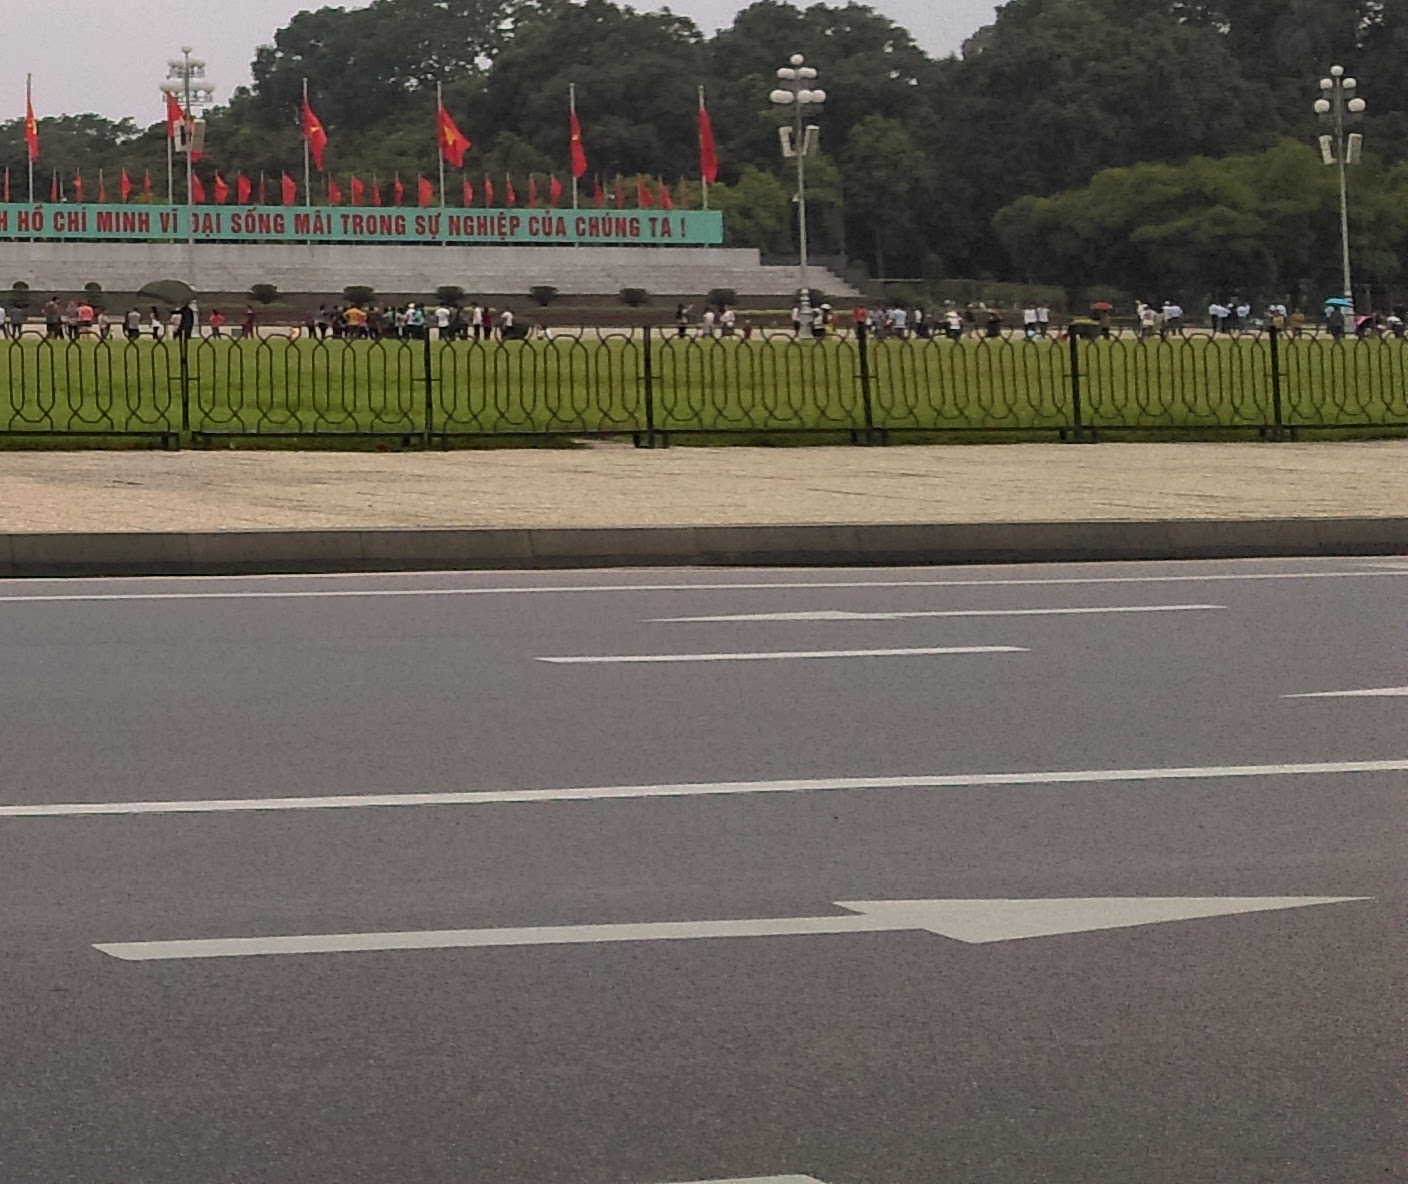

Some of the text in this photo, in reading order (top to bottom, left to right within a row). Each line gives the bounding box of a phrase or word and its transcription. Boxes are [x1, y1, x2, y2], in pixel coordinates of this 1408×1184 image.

[53, 207, 86, 232] CHÍ
[96, 211, 150, 233] MINH
[231, 207, 285, 234] SỐNG
[294, 210, 332, 235] MÃI
[341, 214, 406, 236] TRONG
[415, 212, 441, 239] SỰ
[448, 212, 521, 240] NGHIỆP
[528, 210, 567, 237] CỦA
[575, 213, 641, 238] CHÚNG
[649, 217, 672, 238] TA
